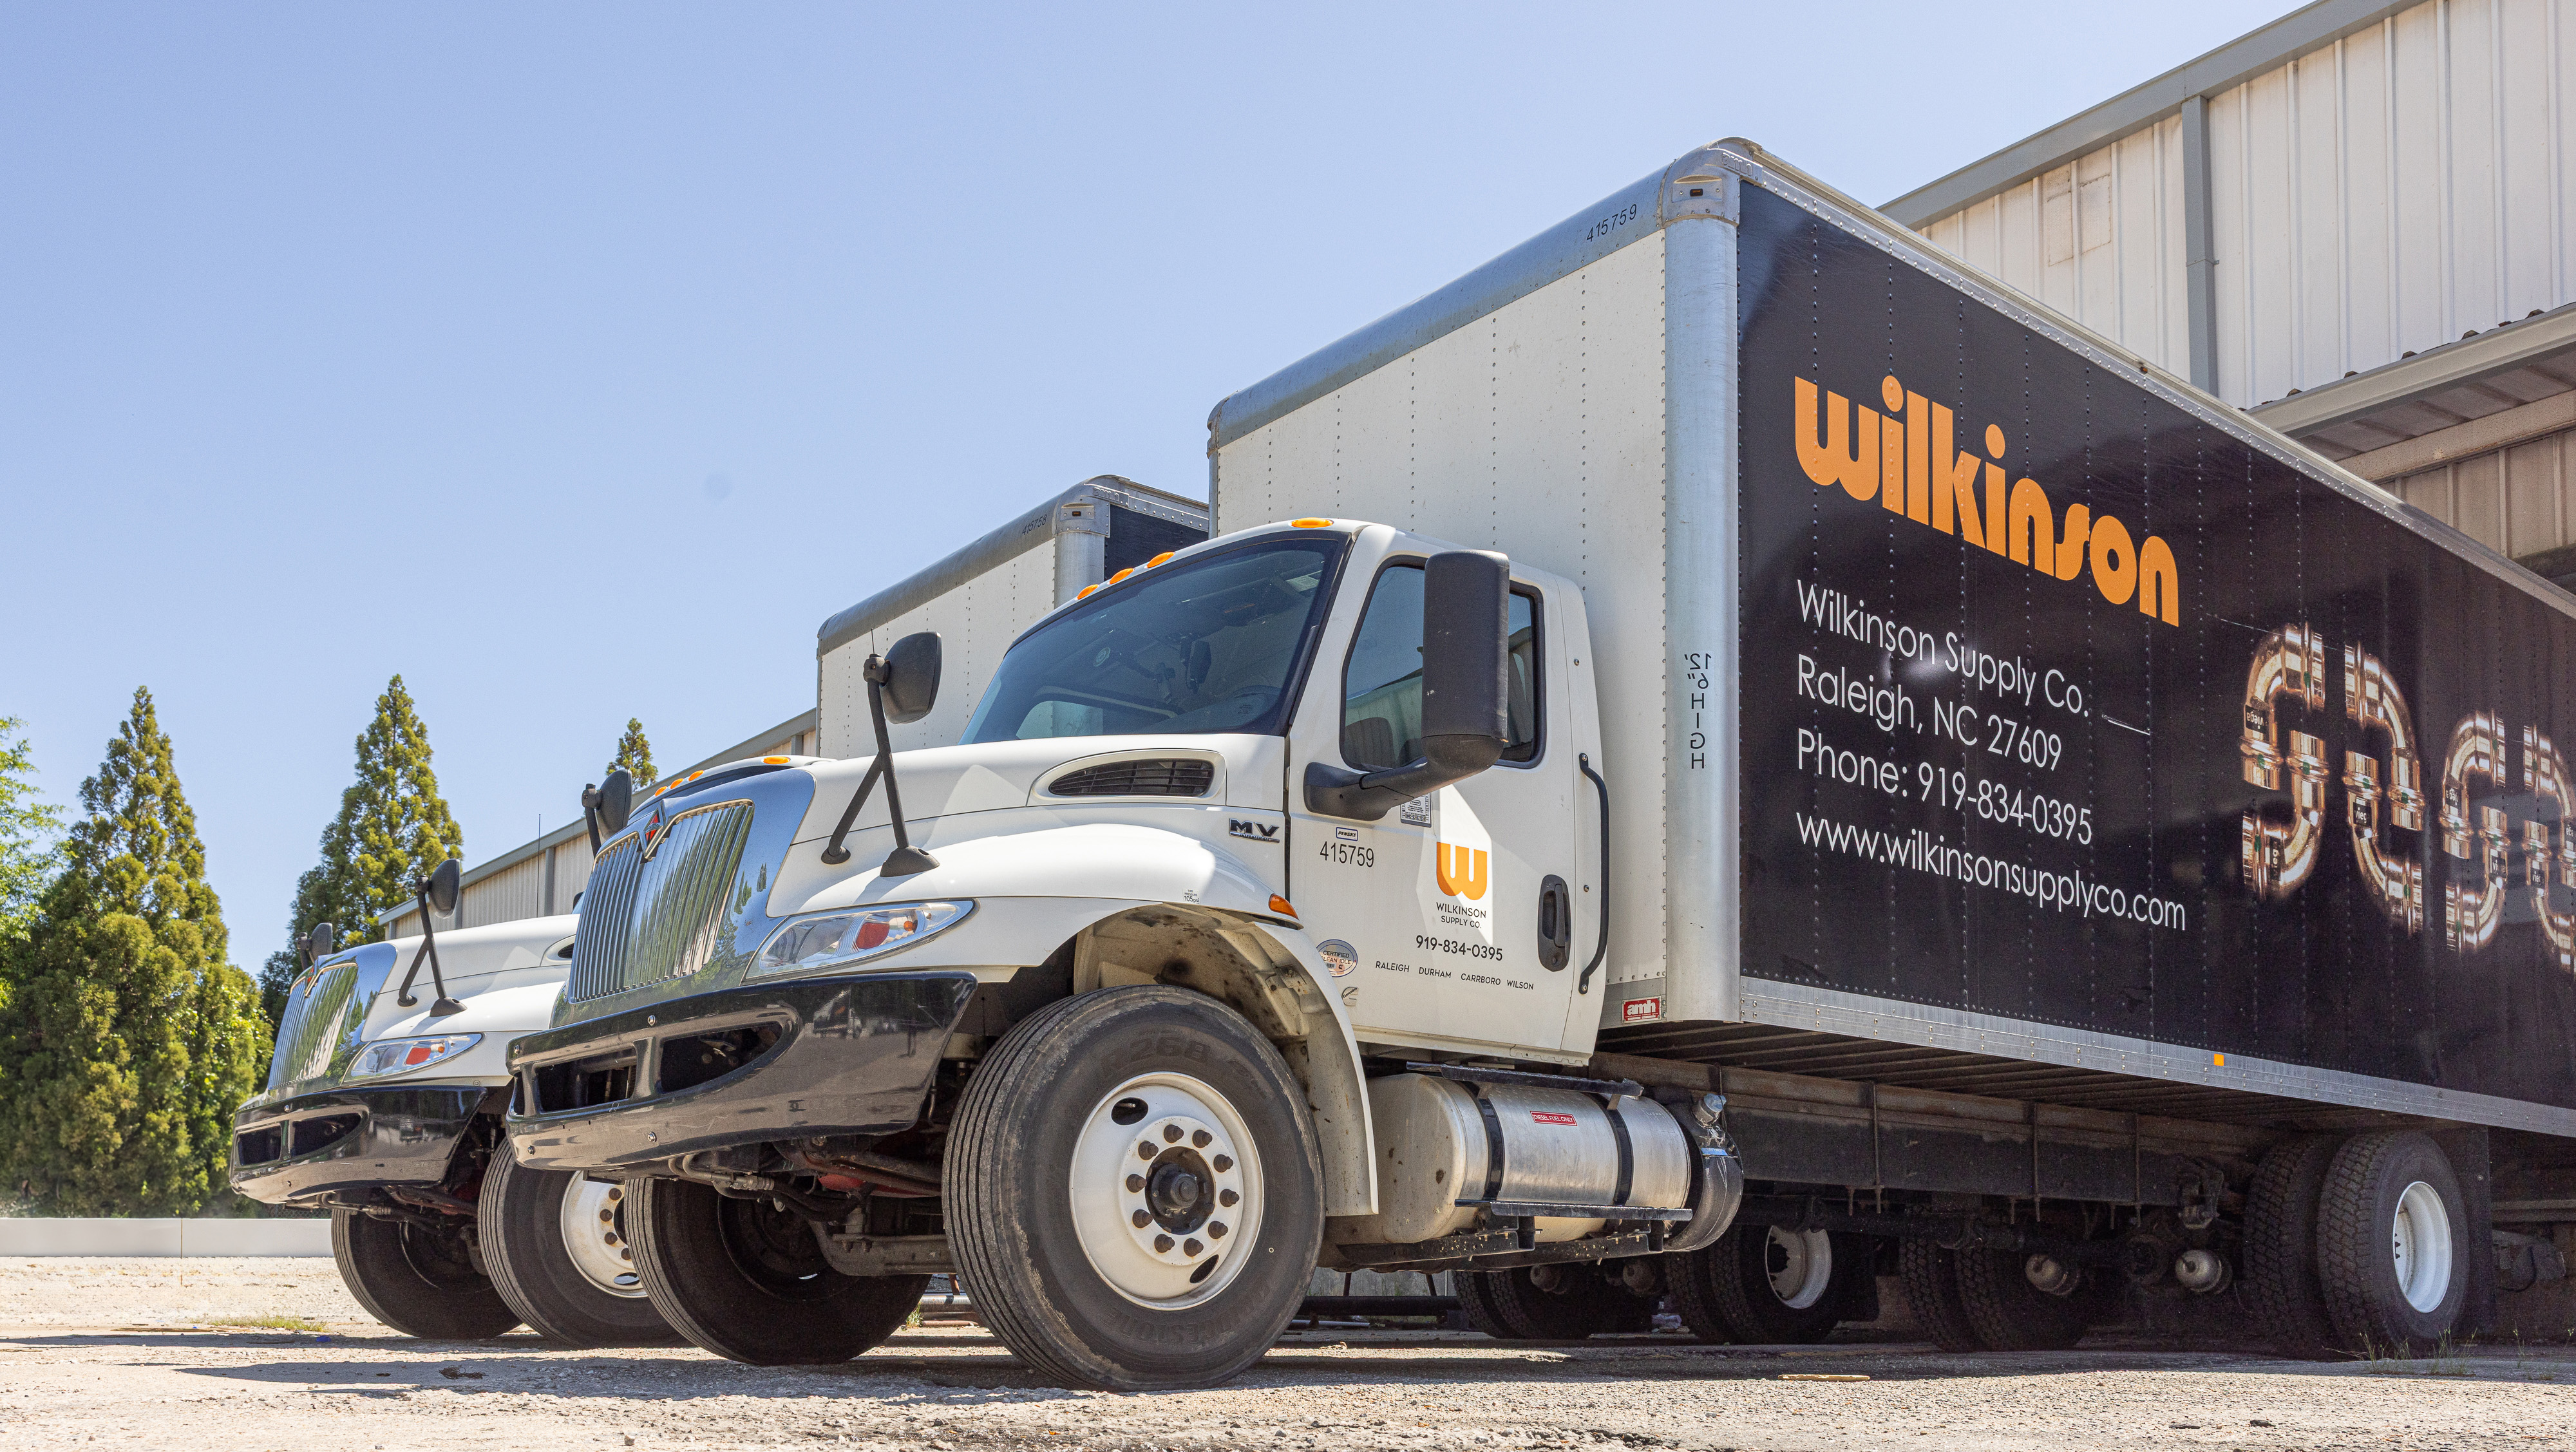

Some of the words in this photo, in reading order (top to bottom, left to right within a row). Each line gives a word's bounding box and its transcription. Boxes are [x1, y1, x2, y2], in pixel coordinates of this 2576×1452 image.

[1587, 203, 1637, 242] 415759
[1795, 375, 2179, 627] wilkinson
[1021, 514, 1047, 536] 415758
[1797, 579, 1935, 665] Wilkinson
[1944, 632, 2036, 706] Supply
[2045, 669, 2089, 717] Co.
[1798, 654, 1924, 734] Raleigh,
[1935, 696, 1978, 746] NC
[1987, 714, 2061, 771] 27609
[1798, 728, 1908, 797] Phone:
[1918, 762, 2092, 845] 919-834-0395
[1229, 818, 1280, 837] MV
[1320, 841, 1374, 868] 415759
[1795, 812, 2185, 931] www.wilkinsonsupplyco.com
[1436, 901, 1486, 919] WILKINSON
[1441, 915, 1468, 926] SUPPLY
[1470, 920, 1482, 929] CO.
[1323, 950, 1350, 959] CERTIFIED
[1416, 934, 1503, 961] 919-834-0395
[1375, 961, 1410, 973] RALEIGH
[1418, 966, 1452, 979] DURHAM
[1461, 973, 1501, 986] CARRBORO
[1506, 979, 1534, 990] WILSON
[1343, 987, 1358, 999] Cummins
[1627, 999, 1656, 1015] amh
